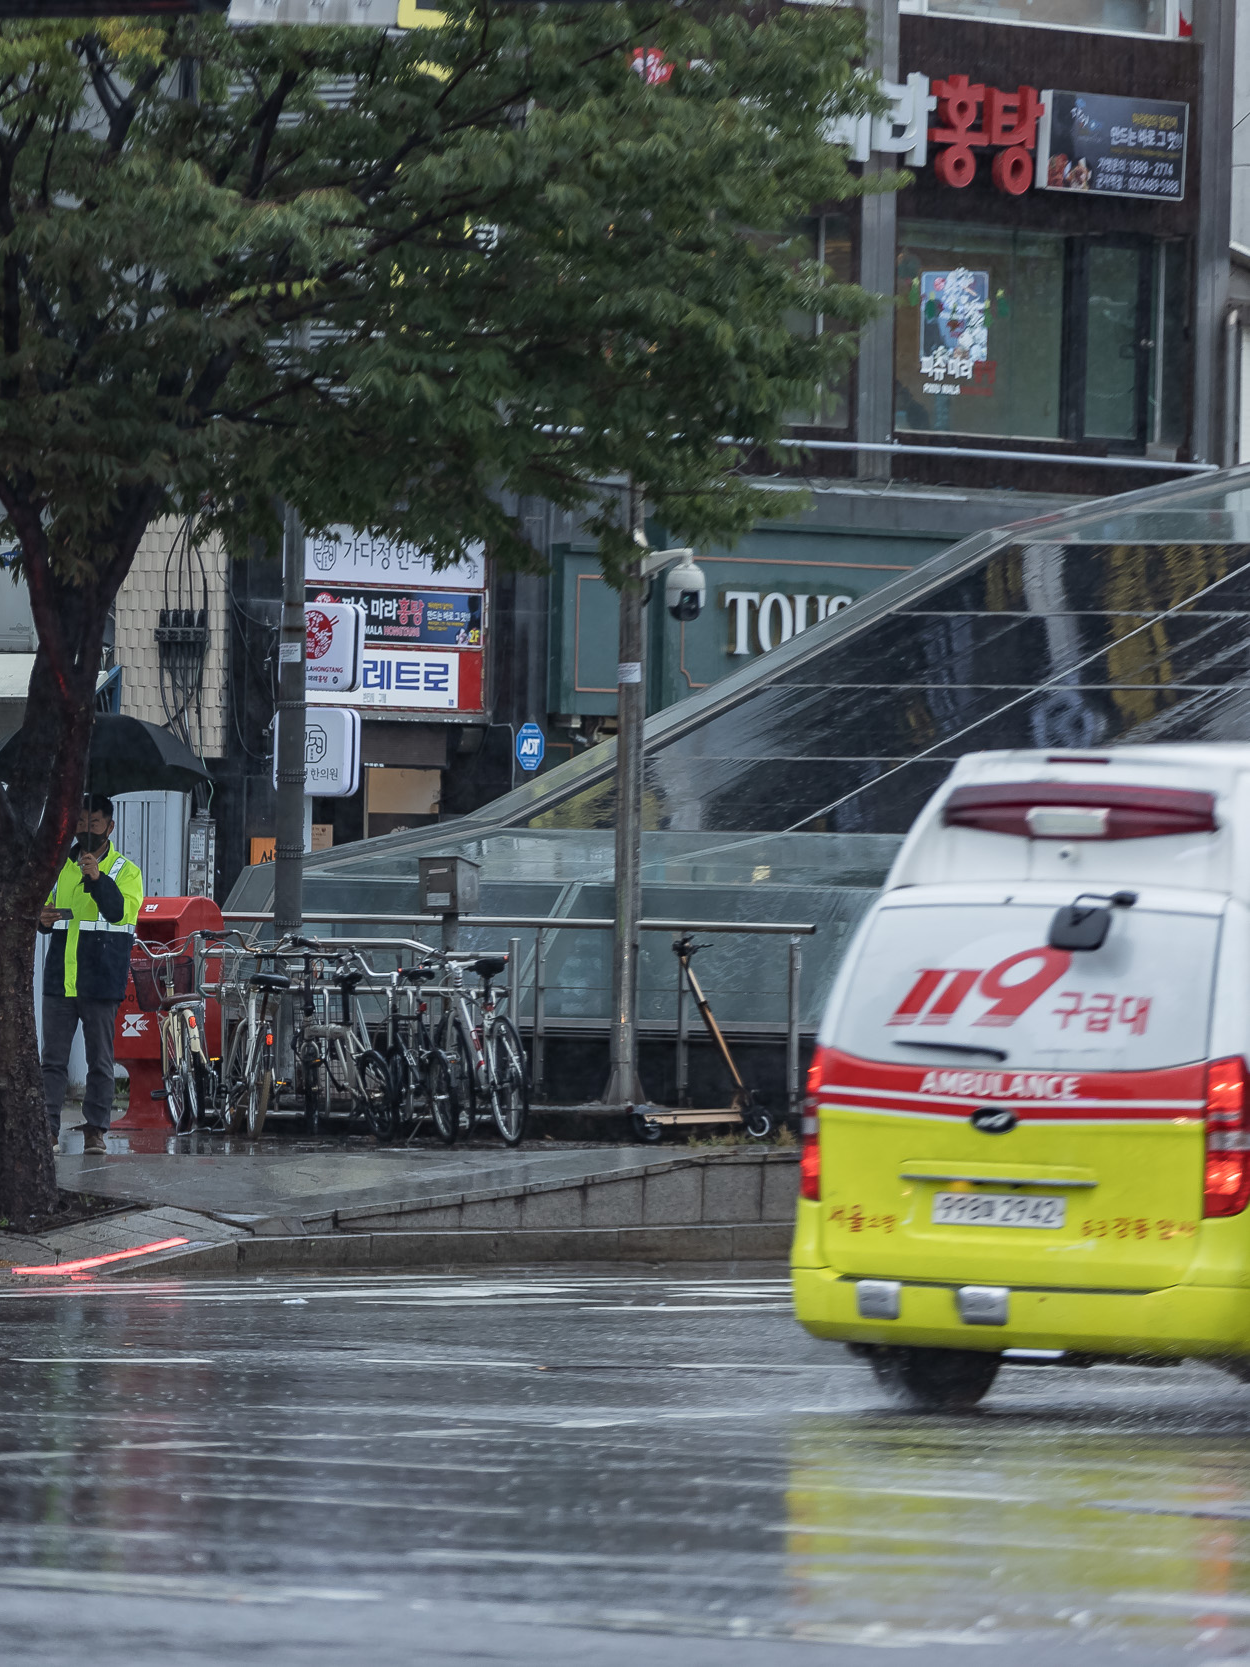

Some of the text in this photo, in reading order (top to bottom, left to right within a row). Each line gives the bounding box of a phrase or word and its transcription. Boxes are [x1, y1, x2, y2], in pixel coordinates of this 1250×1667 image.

[1110, 126, 1137, 147] 만드는
[1156, 131, 1166, 147] 그
[344, 537, 440, 571] 가다정 한의
[466, 564, 479, 580] 3F
[370, 597, 425, 626] 마라홍탕
[469, 629, 480, 643] 2F
[363, 660, 449, 691] 레트로
[520, 738, 540, 755] ADT
[311, 767, 338, 781] 한의원
[883, 945, 1153, 1036] 119 구급대
[919, 1070, 1082, 1100] AMBULANCE
